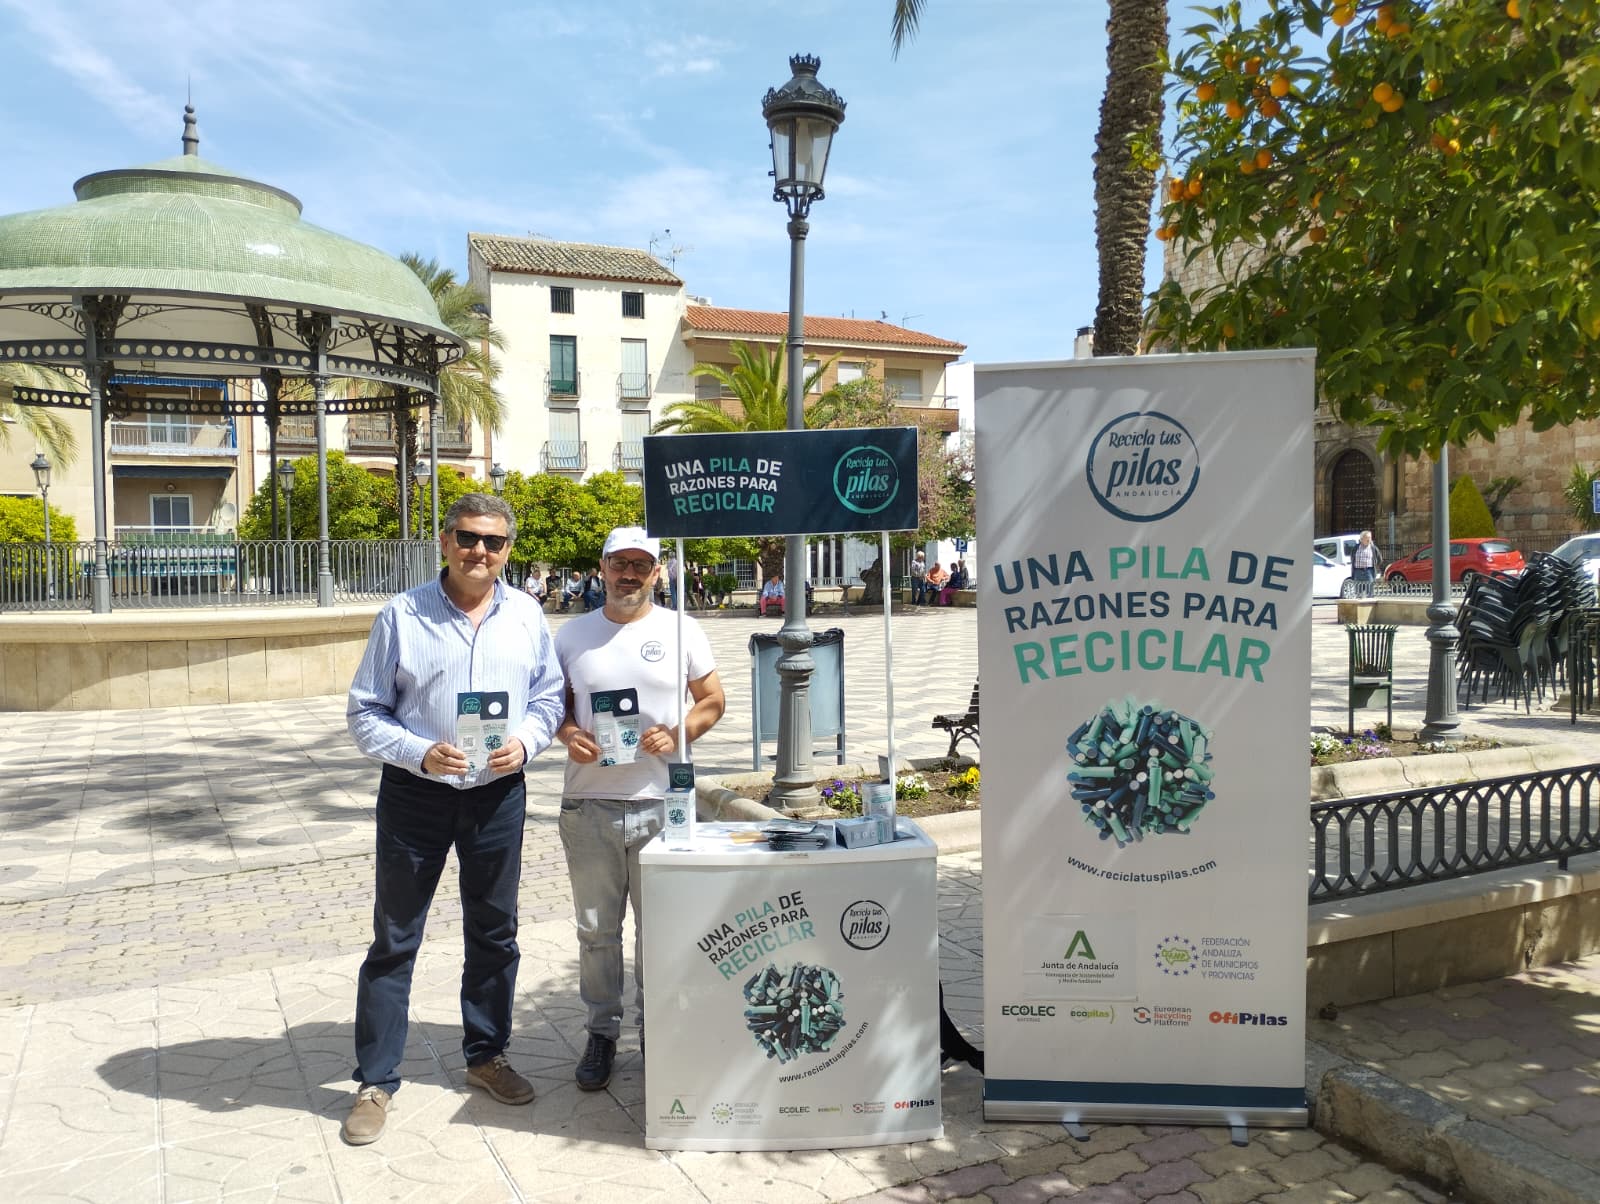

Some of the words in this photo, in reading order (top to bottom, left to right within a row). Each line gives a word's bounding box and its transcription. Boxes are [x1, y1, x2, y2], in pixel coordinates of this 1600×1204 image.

[1108, 428, 1155, 448] Recicla
[1159, 429, 1182, 446] tus
[664, 459, 705, 479] UNA
[709, 457, 751, 473] PILA
[756, 458, 783, 477] DE
[1105, 447, 1182, 498] pilas
[669, 476, 736, 496] RAZONES
[739, 476, 778, 493] PARA
[845, 467, 890, 499] pilas
[673, 491, 776, 516] RECICLAR
[958, 539, 966, 550] P
[993, 550, 1094, 596] UNA
[1108, 545, 1211, 581] PILA
[1227, 550, 1295, 592] DE
[1004, 591, 1170, 634] RAZONES
[1183, 592, 1279, 631] PARA
[1013, 628, 1271, 685] RECICLAR
[1067, 856, 1217, 884] www.reciclatuspilas.com
[696, 922, 735, 953] UNA
[735, 900, 775, 928] PILA
[778, 890, 804, 910] DE
[849, 916, 883, 940] pilas
[708, 921, 768, 965] RAZONES
[770, 907, 809, 928] PARA
[1201, 937, 1250, 947] FEDERACIÓN
[717, 919, 816, 981] RECICLAR
[1201, 949, 1242, 958] ANDALUZA
[1040, 961, 1065, 969] Junta
[1066, 961, 1077, 970] de
[1078, 961, 1119, 971] Andalucía
[1201, 960, 1212, 968] DE
[1213, 960, 1259, 969] MUNICIPIOS
[1201, 971, 1207, 979] Y
[1208, 971, 1255, 981] PROVINCIAS
[1001, 1004, 1056, 1017] ECOLEC
[1070, 1009, 1110, 1019] ecopilas
[1153, 1005, 1192, 1014] European
[1153, 1012, 1192, 1021] Recycling
[1153, 1019, 1189, 1027] Platform
[778, 1021, 869, 1083] www.reciclatuspilas.com
[778, 1105, 811, 1115] ECOLEC
